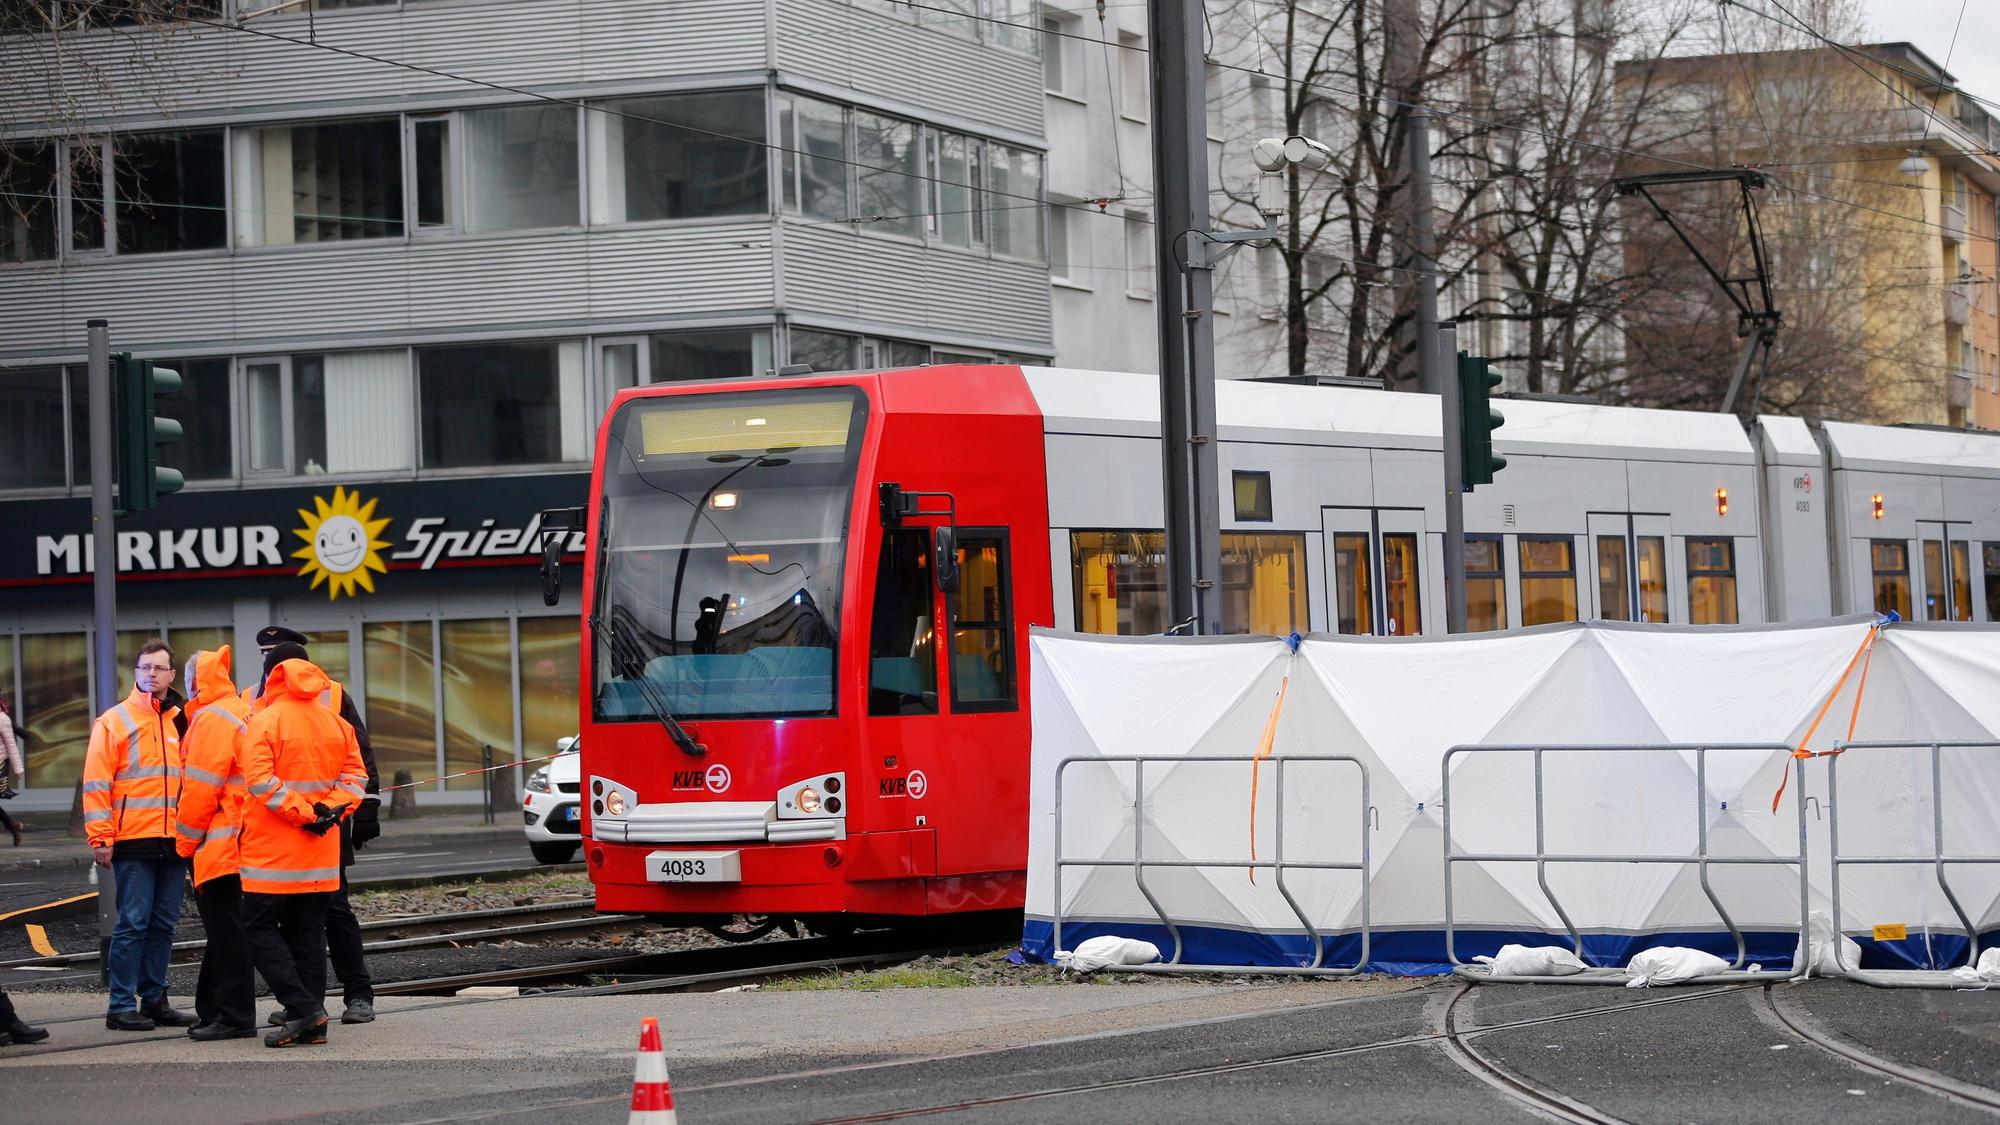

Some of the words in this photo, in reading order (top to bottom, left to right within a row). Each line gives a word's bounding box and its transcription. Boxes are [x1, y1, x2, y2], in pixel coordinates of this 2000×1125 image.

[673, 771, 704, 787] KVB
[879, 777, 906, 795] KVB
[661, 860, 705, 876] 4083
